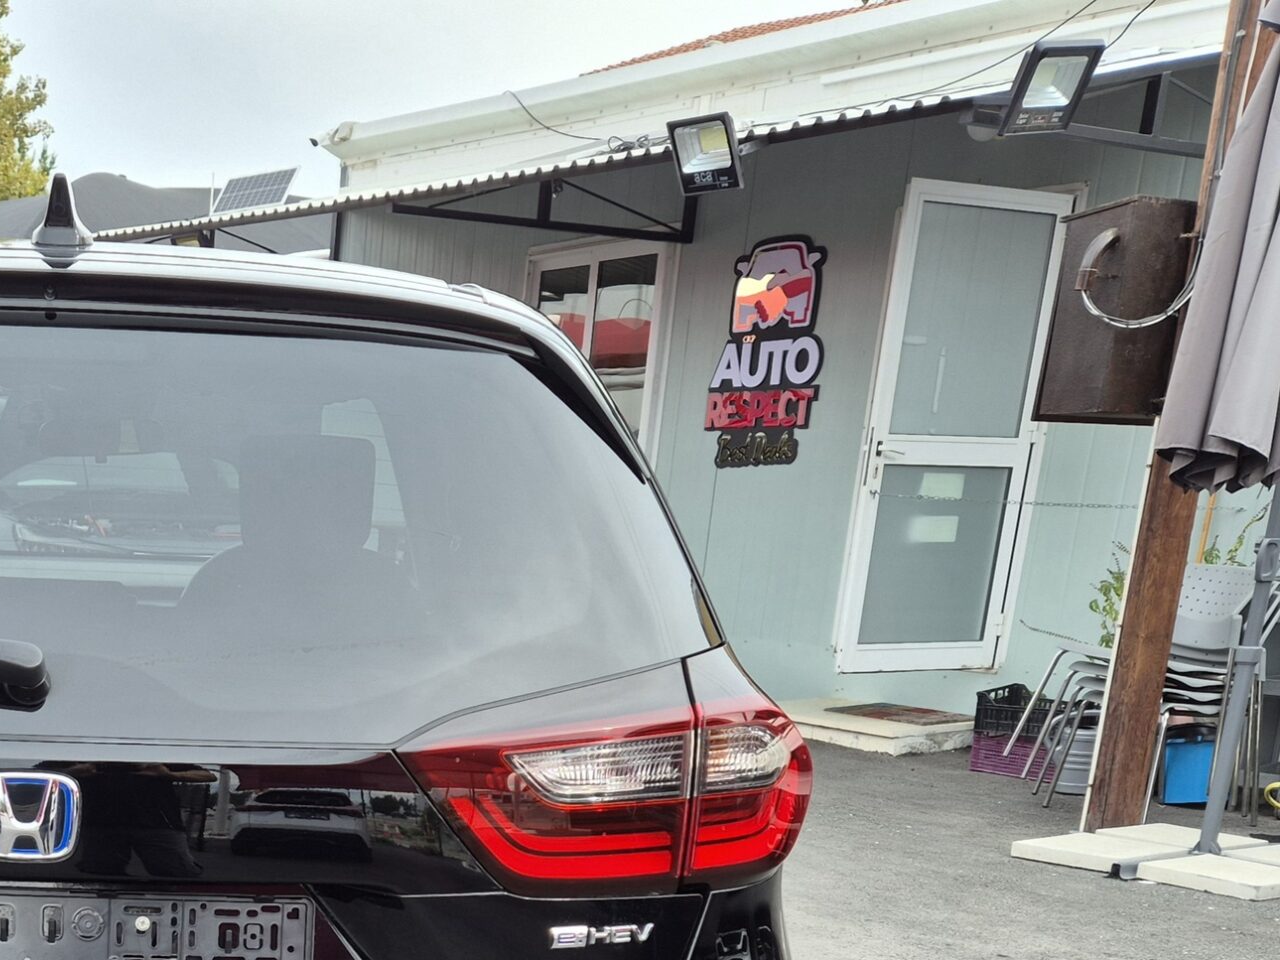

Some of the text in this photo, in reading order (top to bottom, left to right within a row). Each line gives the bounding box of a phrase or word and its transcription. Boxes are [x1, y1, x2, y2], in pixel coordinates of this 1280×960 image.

[710, 336, 820, 388] AUTO
[705, 387, 816, 429] RESPECT
[716, 431, 752, 464] Best
